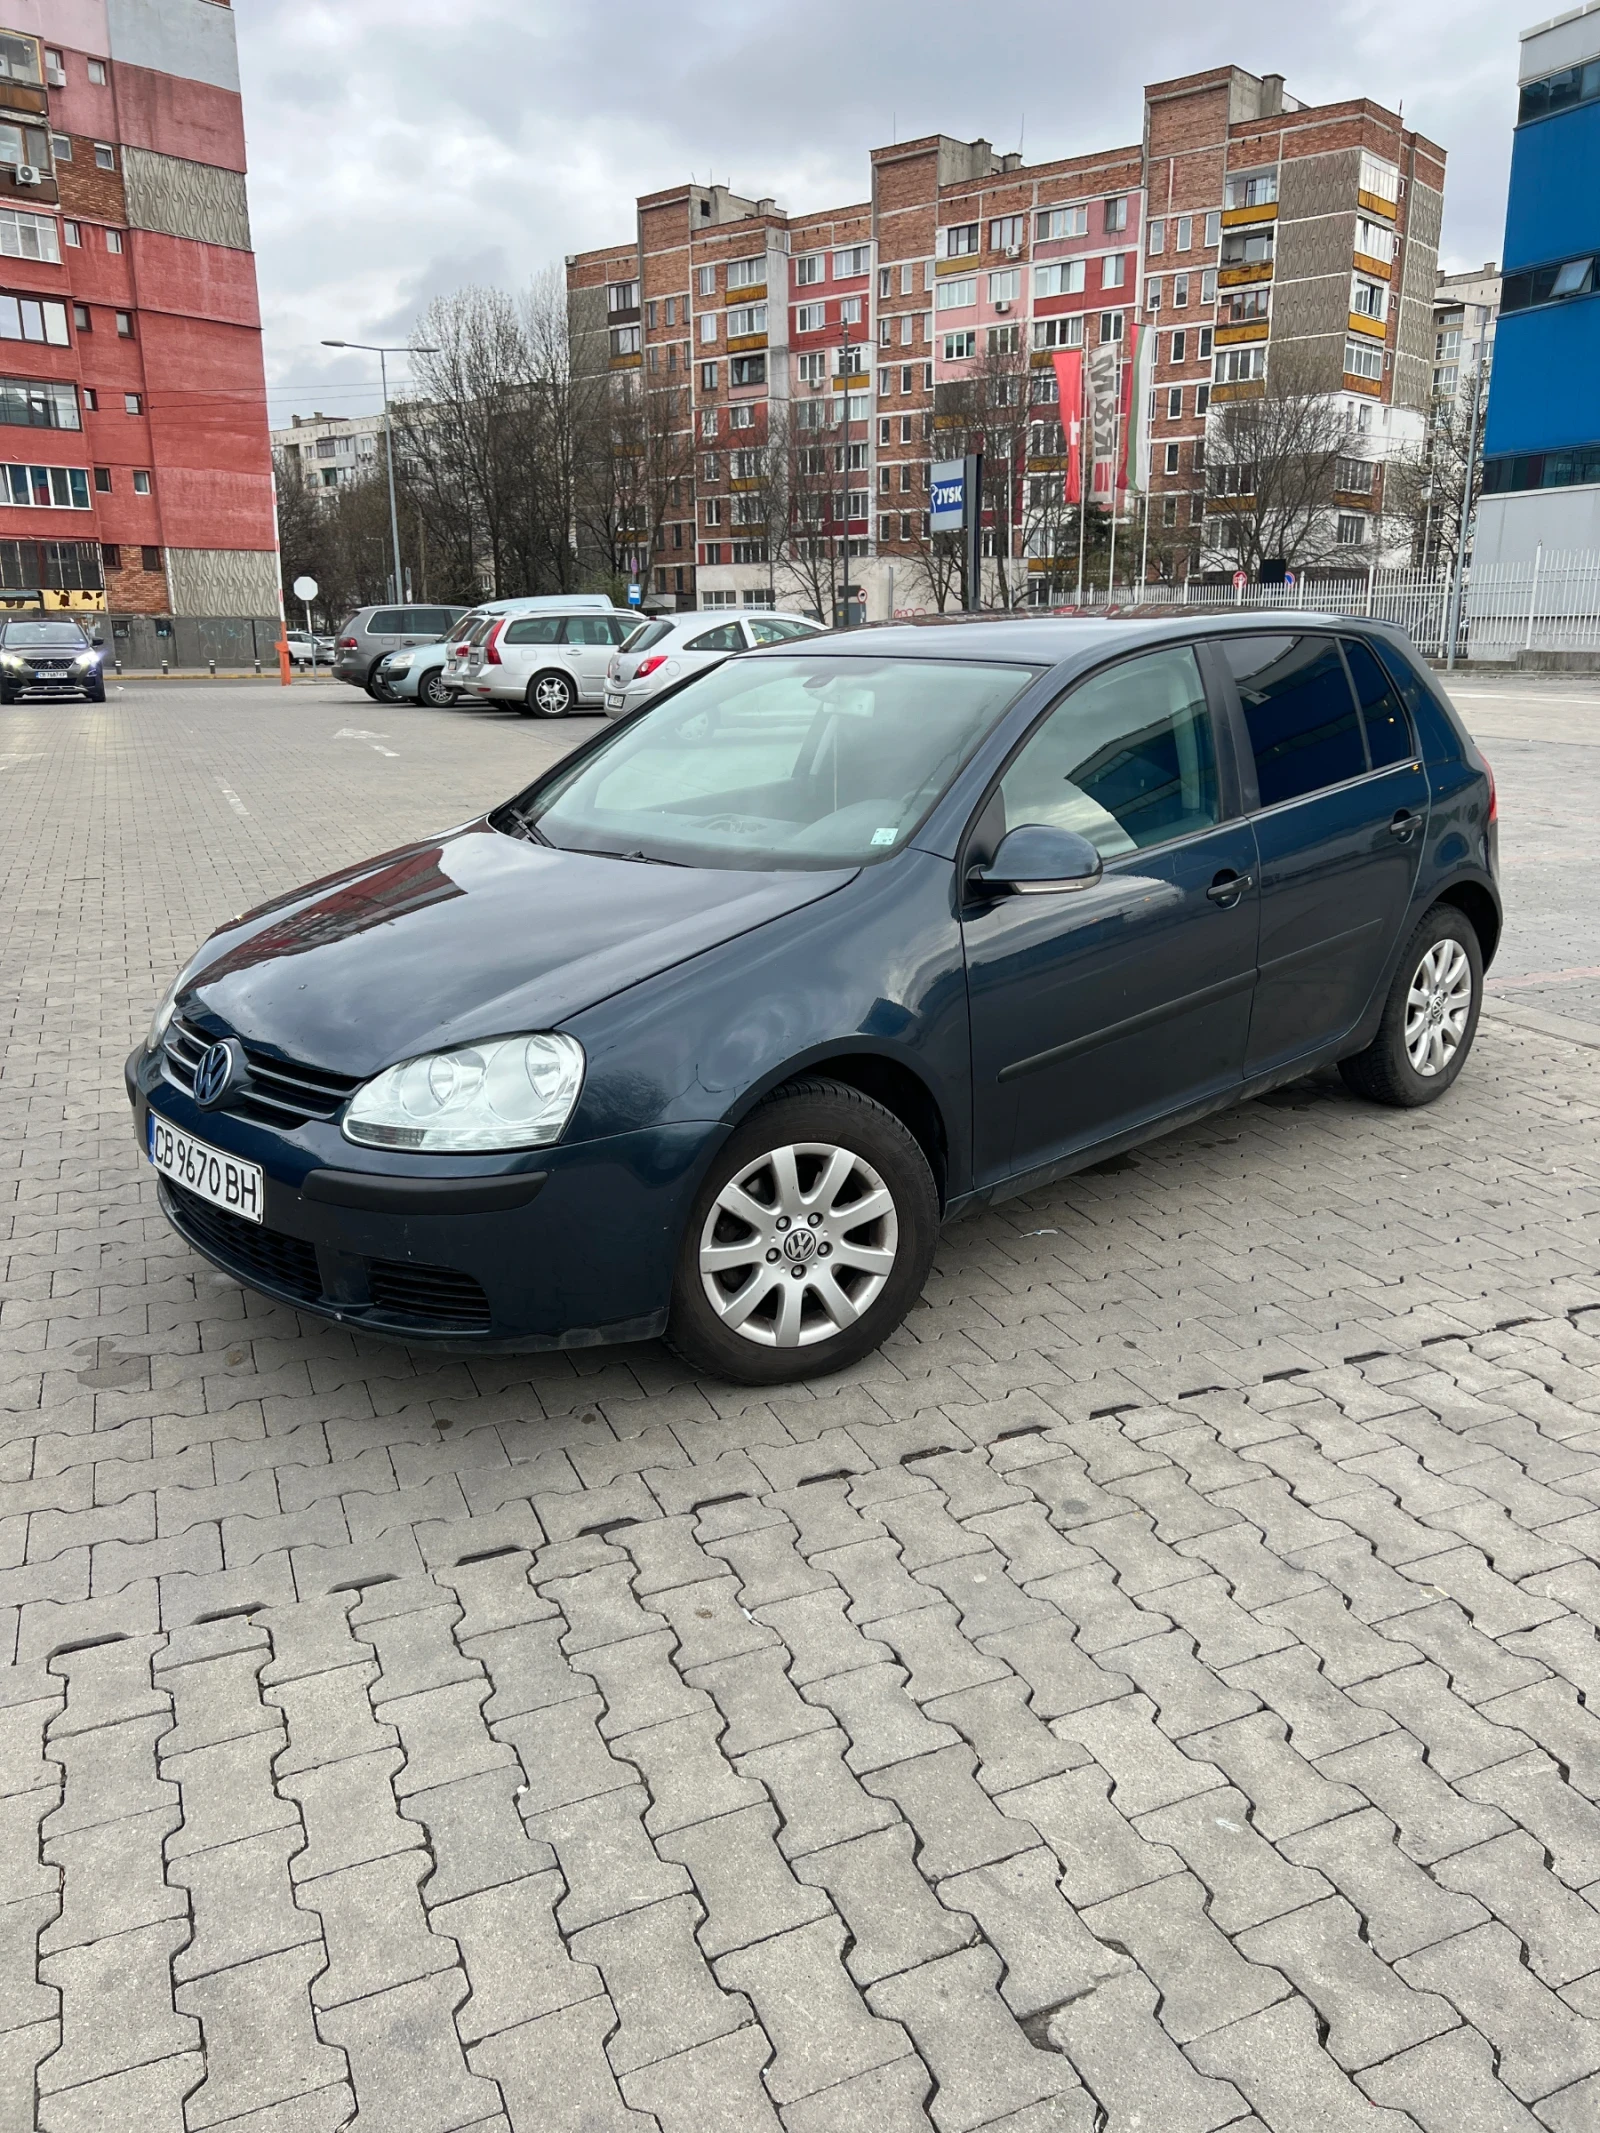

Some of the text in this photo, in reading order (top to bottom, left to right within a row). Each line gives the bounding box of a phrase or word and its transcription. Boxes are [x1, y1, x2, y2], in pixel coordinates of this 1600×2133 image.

[936, 485, 963, 506] JYSK
[195, 1043, 230, 1102] VW
[154, 1124, 257, 1213] CB 9670 BH
[786, 1231, 815, 1260] VW
